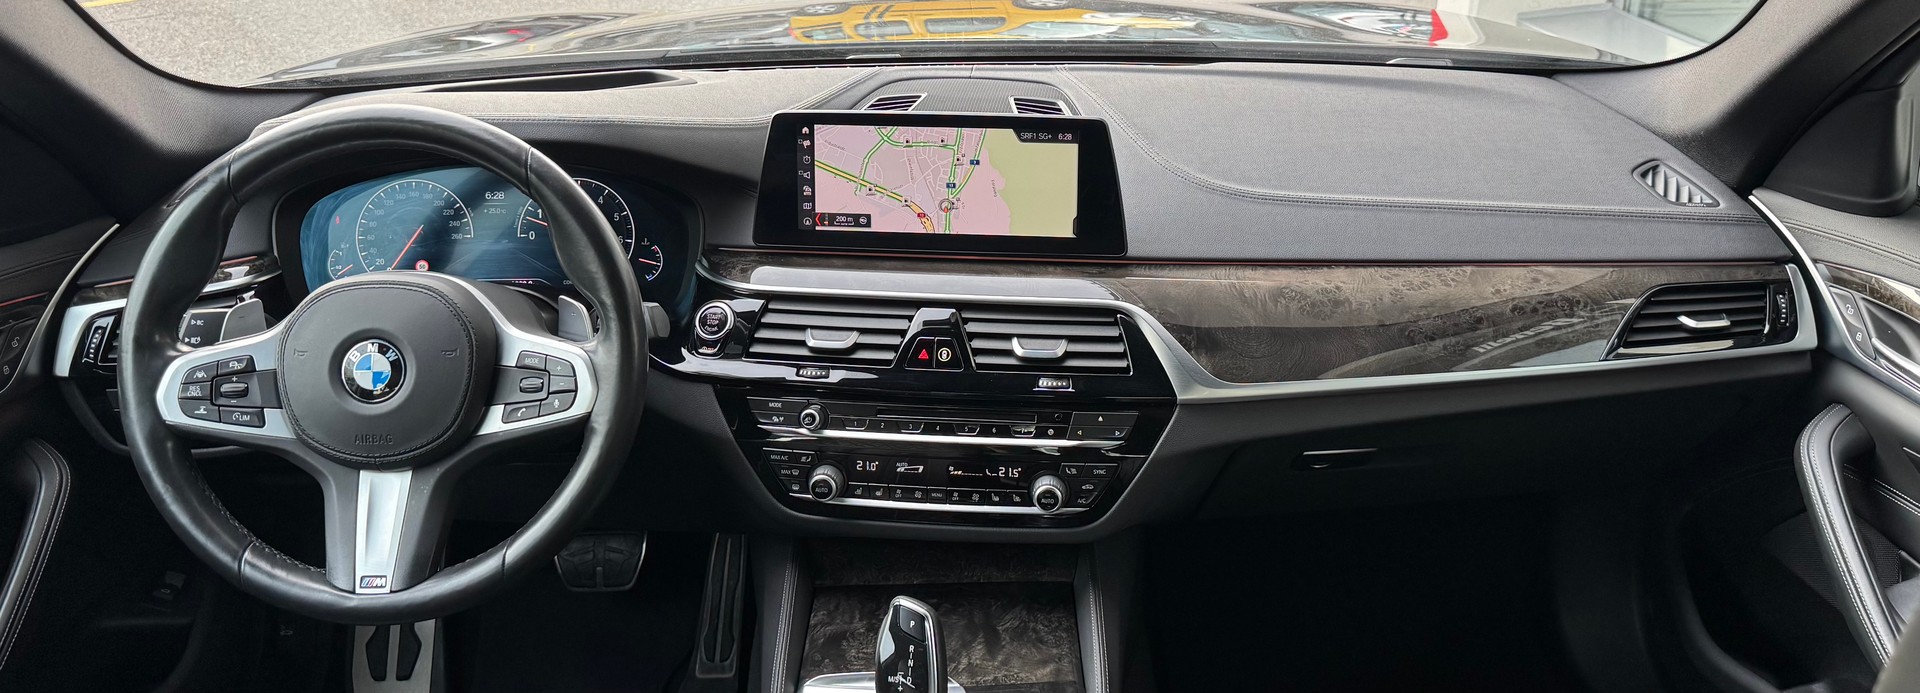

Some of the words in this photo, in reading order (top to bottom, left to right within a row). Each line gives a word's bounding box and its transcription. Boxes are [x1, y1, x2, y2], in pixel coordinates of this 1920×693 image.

[1020, 132, 1036, 140] SRF1
[1038, 132, 1052, 140] SG+
[485, 191, 505, 200] 6:28
[597, 195, 604, 205] 4
[537, 209, 542, 219] 1
[613, 213, 620, 221] 5
[528, 231, 536, 240] 0
[618, 235, 624, 243] 6
[349, 343, 399, 363] BMW
[354, 433, 393, 445] AIRBAG
[909, 620, 915, 628] P
[909, 644, 915, 652] R
[907, 659, 914, 667] N
[906, 676, 912, 684] D
